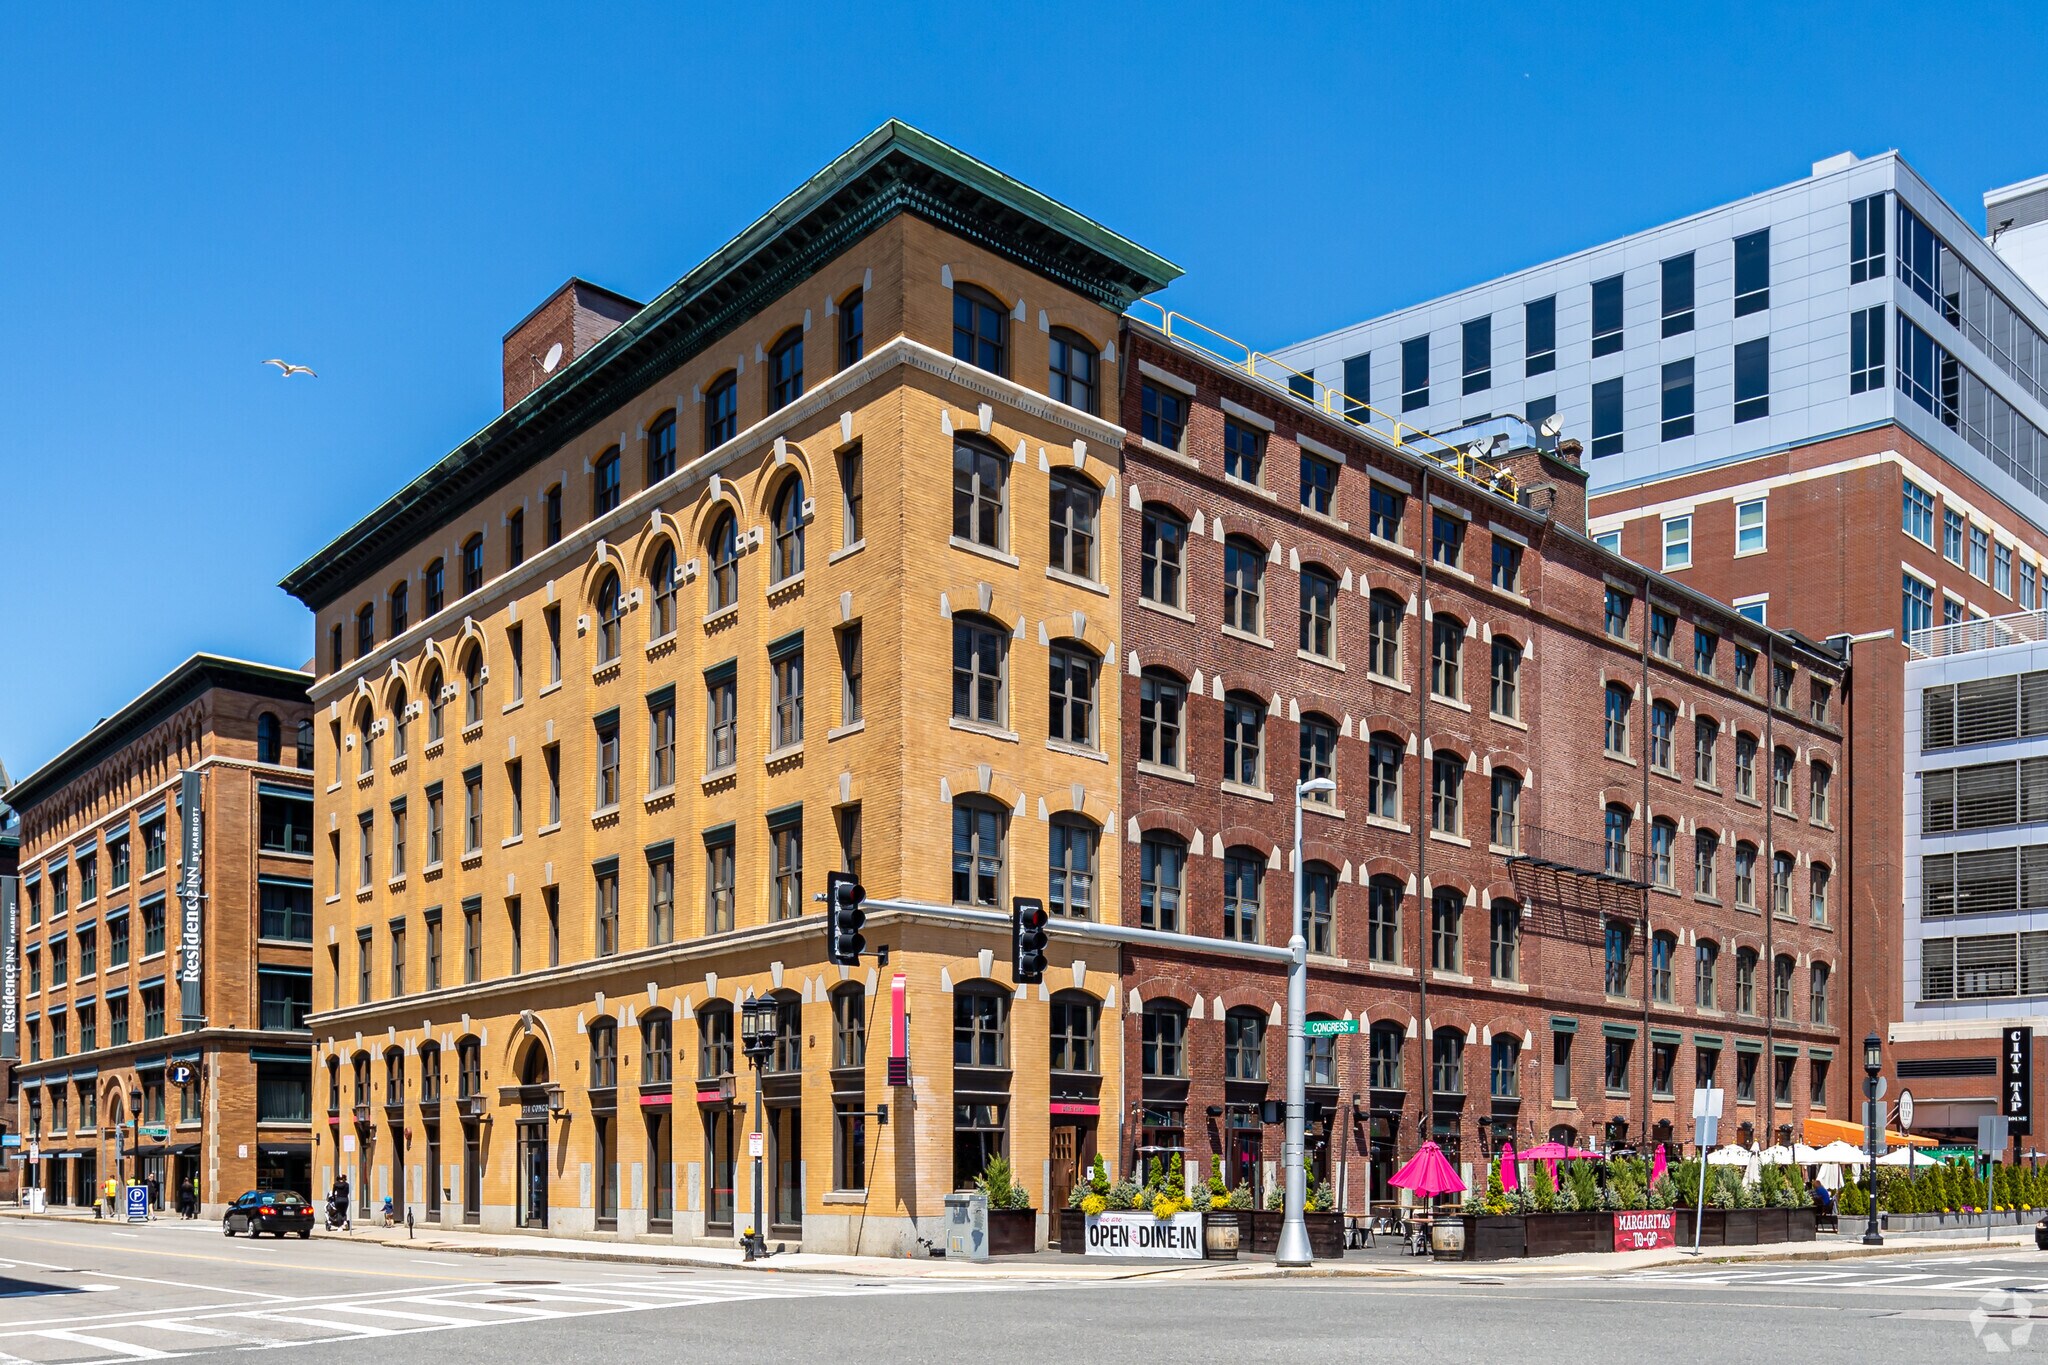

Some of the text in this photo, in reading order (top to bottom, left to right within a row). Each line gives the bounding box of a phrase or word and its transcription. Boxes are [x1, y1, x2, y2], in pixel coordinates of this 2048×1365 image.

[192, 851, 199, 862] BY
[187, 867, 199, 888] INN
[183, 890, 199, 982] Residence
[5, 946, 15, 963] INN
[2, 963, 16, 1033] Residence
[1312, 1021, 1349, 1033] CONGRESS
[2010, 1031, 2022, 1074] CITY
[176, 1067, 190, 1082] P
[2010, 1082, 2022, 1112] TAP
[134, 1191, 142, 1200] P
[1618, 1213, 1671, 1231] MARGARITAS
[1089, 1224, 1129, 1248] OPEN
[1633, 1231, 1658, 1247] TO-GO
